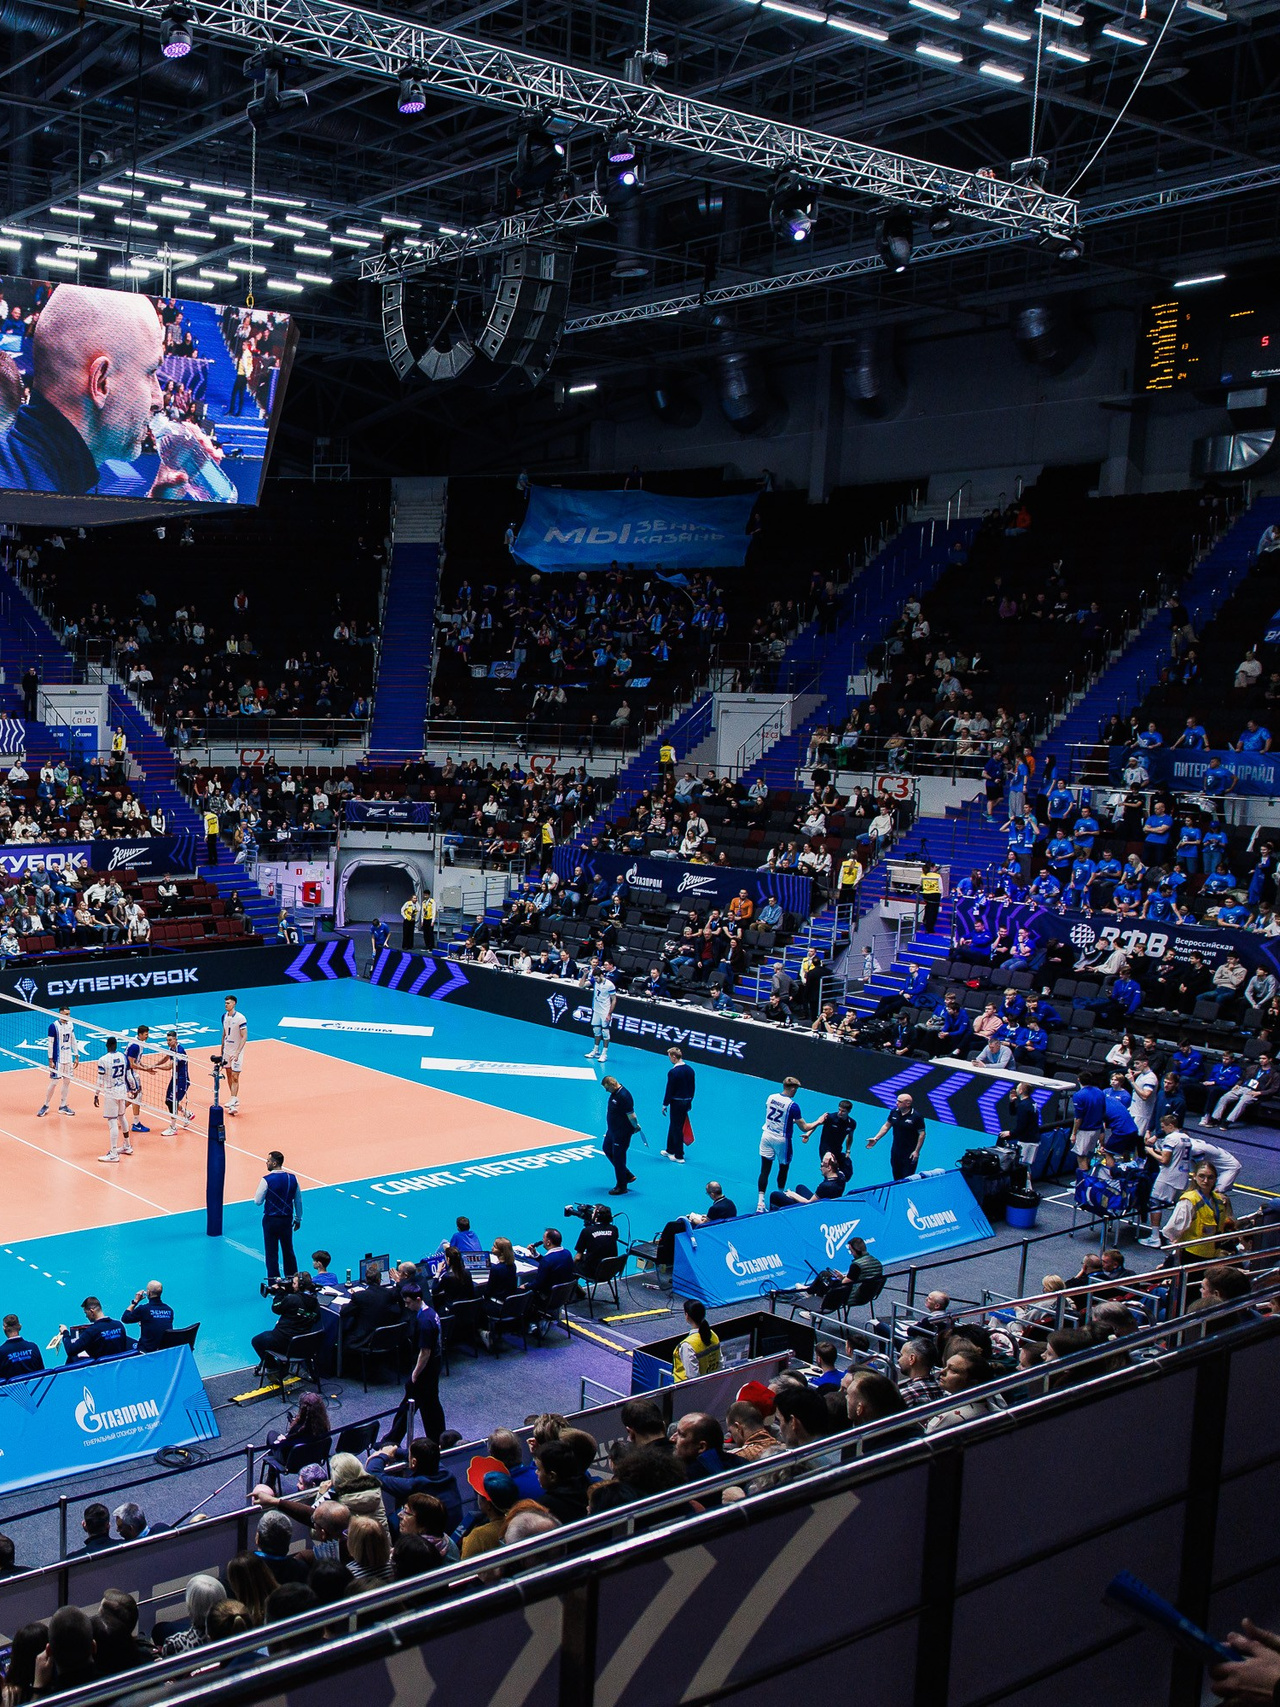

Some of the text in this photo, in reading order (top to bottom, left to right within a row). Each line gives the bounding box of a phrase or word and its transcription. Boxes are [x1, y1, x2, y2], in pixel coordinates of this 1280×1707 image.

[543, 523, 631, 544] МЫ
[1237, 764, 1275, 783] ПРАЙД
[107, 846, 150, 872] Зенит
[635, 876, 663, 888] ГАЗПРОМ
[677, 872, 717, 893] Зенит
[1174, 936, 1235, 951] Всероссийская
[47, 967, 199, 996] СУПЕРКУБОК
[572, 1004, 748, 1060] СПЕРКУБОК
[111, 1064, 125, 1079] 23
[766, 1106, 785, 1123] 22
[370, 1145, 597, 1196] САНКТ-ПЕТЕРБУРГ
[925, 1210, 958, 1229] ГАЗПРОМ
[819, 1218, 861, 1260] Зенит
[744, 1253, 784, 1275] ГАЗПРОМ
[101, 1399, 160, 1430] ГАЗПРОМ
